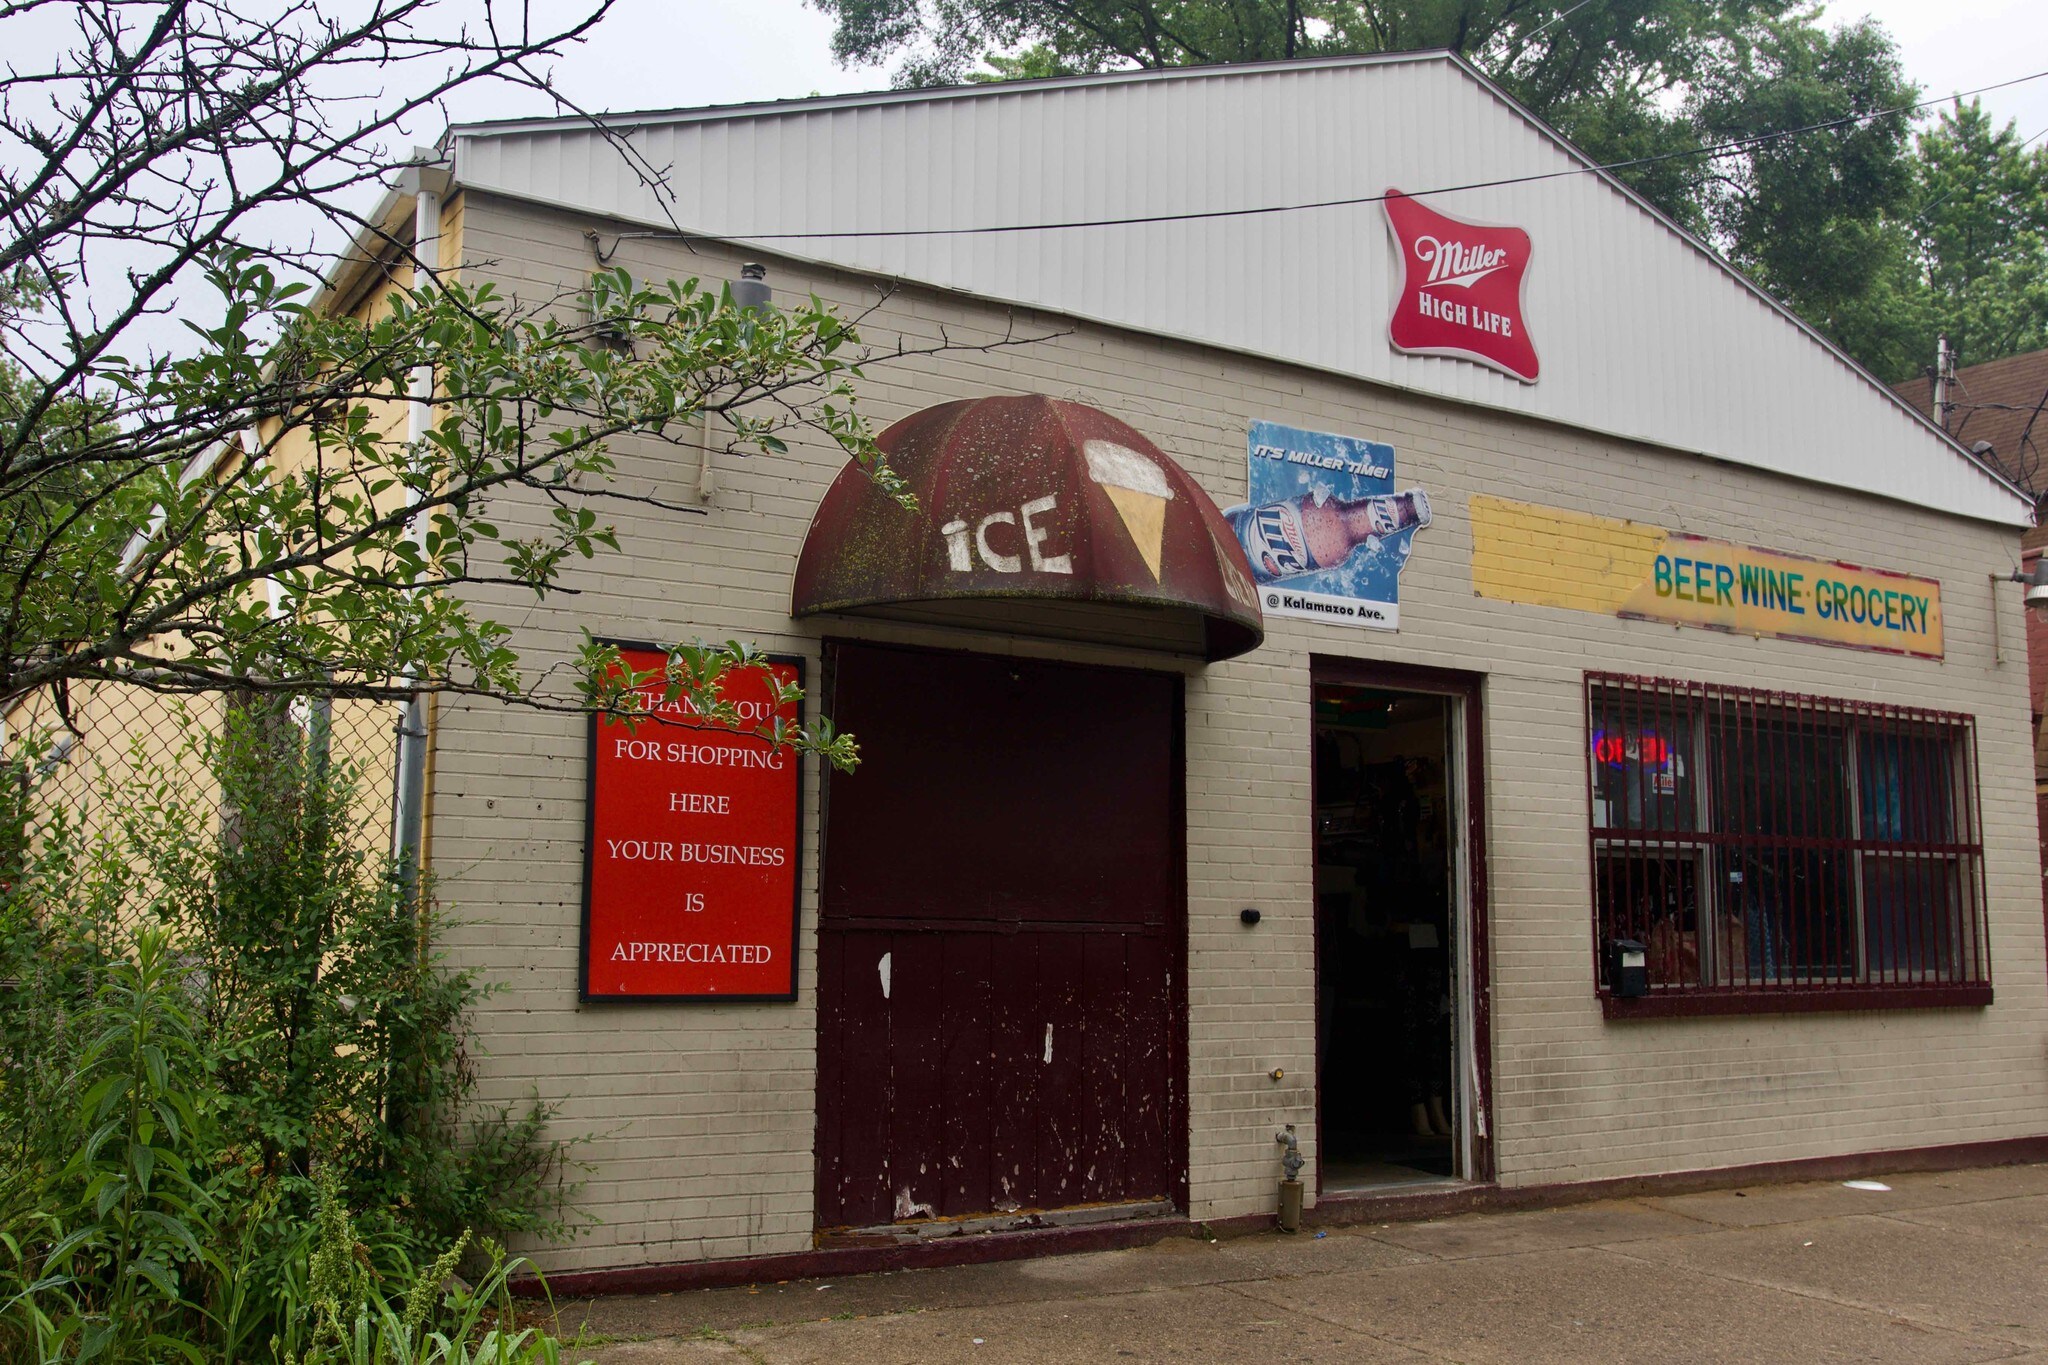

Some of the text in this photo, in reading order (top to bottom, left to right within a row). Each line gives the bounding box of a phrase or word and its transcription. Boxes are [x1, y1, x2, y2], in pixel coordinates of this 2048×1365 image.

[1414, 235, 1507, 282] Miller
[1418, 291, 1512, 338] HIGH LIFE
[1288, 450, 1344, 473] MILLER
[1267, 594, 1386, 621] @ Kalamazoo Ave.
[1654, 554, 1929, 635] BEER WINE GROCERY
[632, 690, 771, 722] THAN OU
[614, 738, 784, 770] FOR SHOPPING
[669, 792, 731, 815] HERE
[607, 839, 785, 867] YOUR BUSINESS
[684, 892, 705, 913] IS
[610, 941, 772, 965] APPRECIATED
